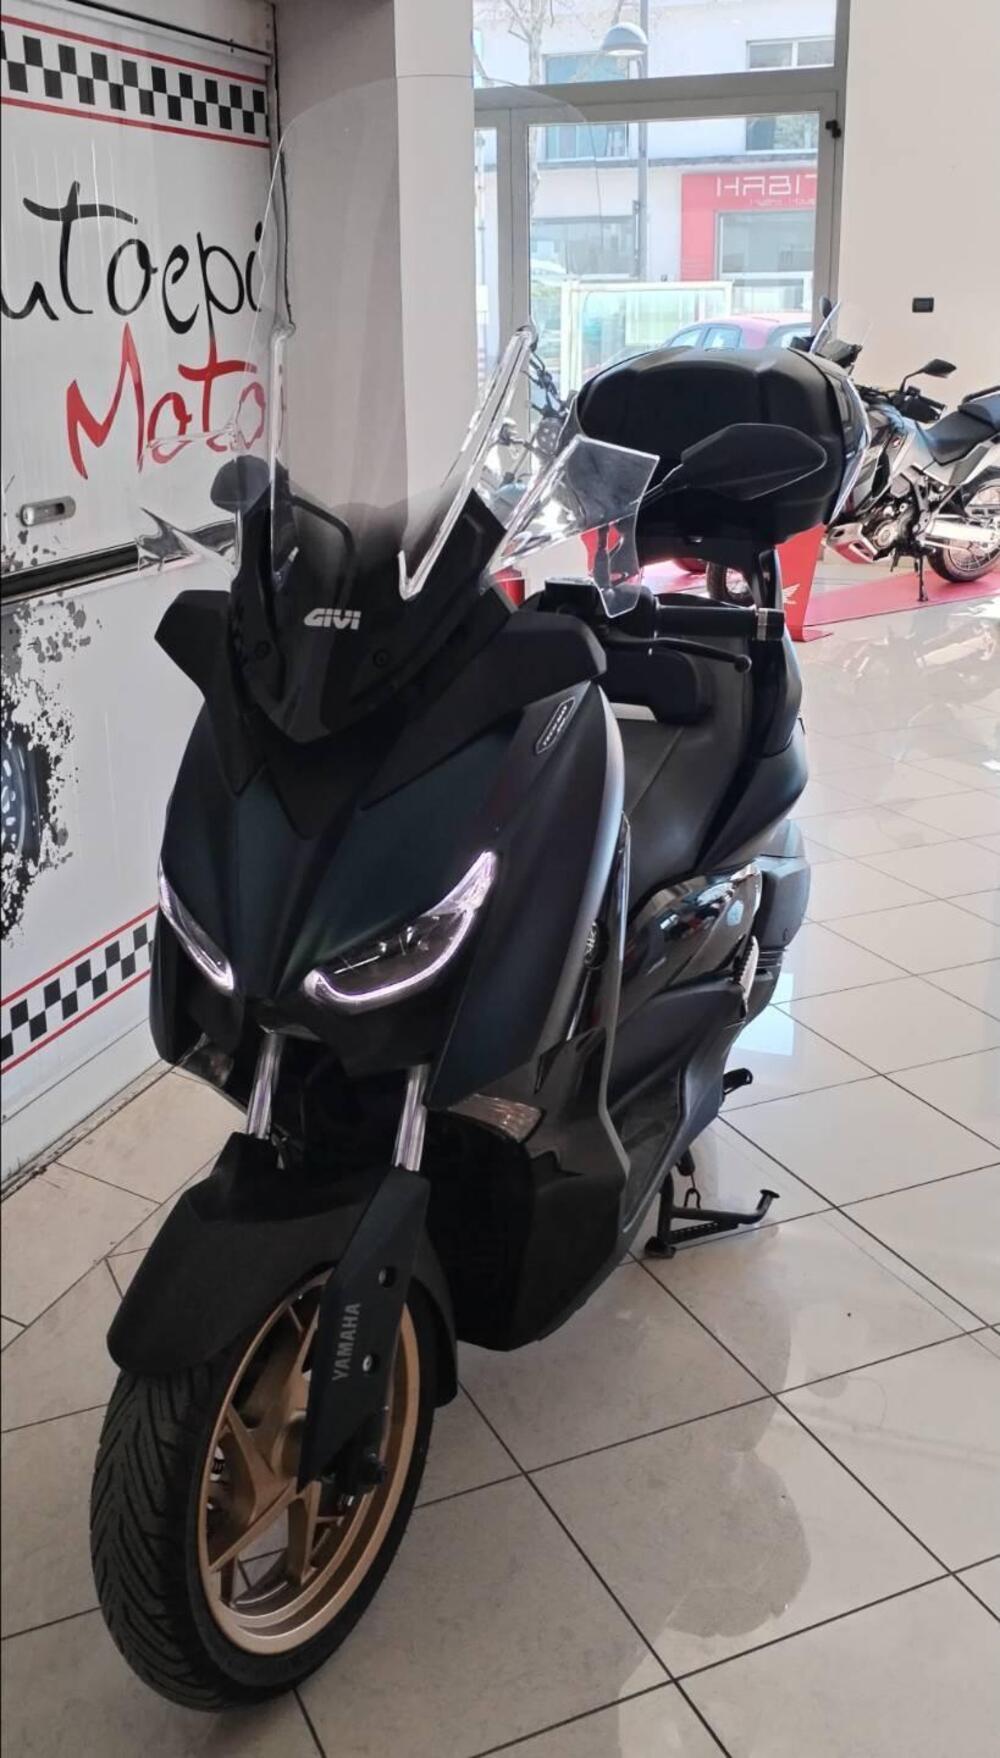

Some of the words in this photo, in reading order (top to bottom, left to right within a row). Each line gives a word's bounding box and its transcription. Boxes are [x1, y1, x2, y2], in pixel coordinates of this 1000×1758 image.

[66, 321, 266, 480] Moto
[304, 608, 361, 630] GIVI
[332, 1303, 361, 1381] YAMAHA
